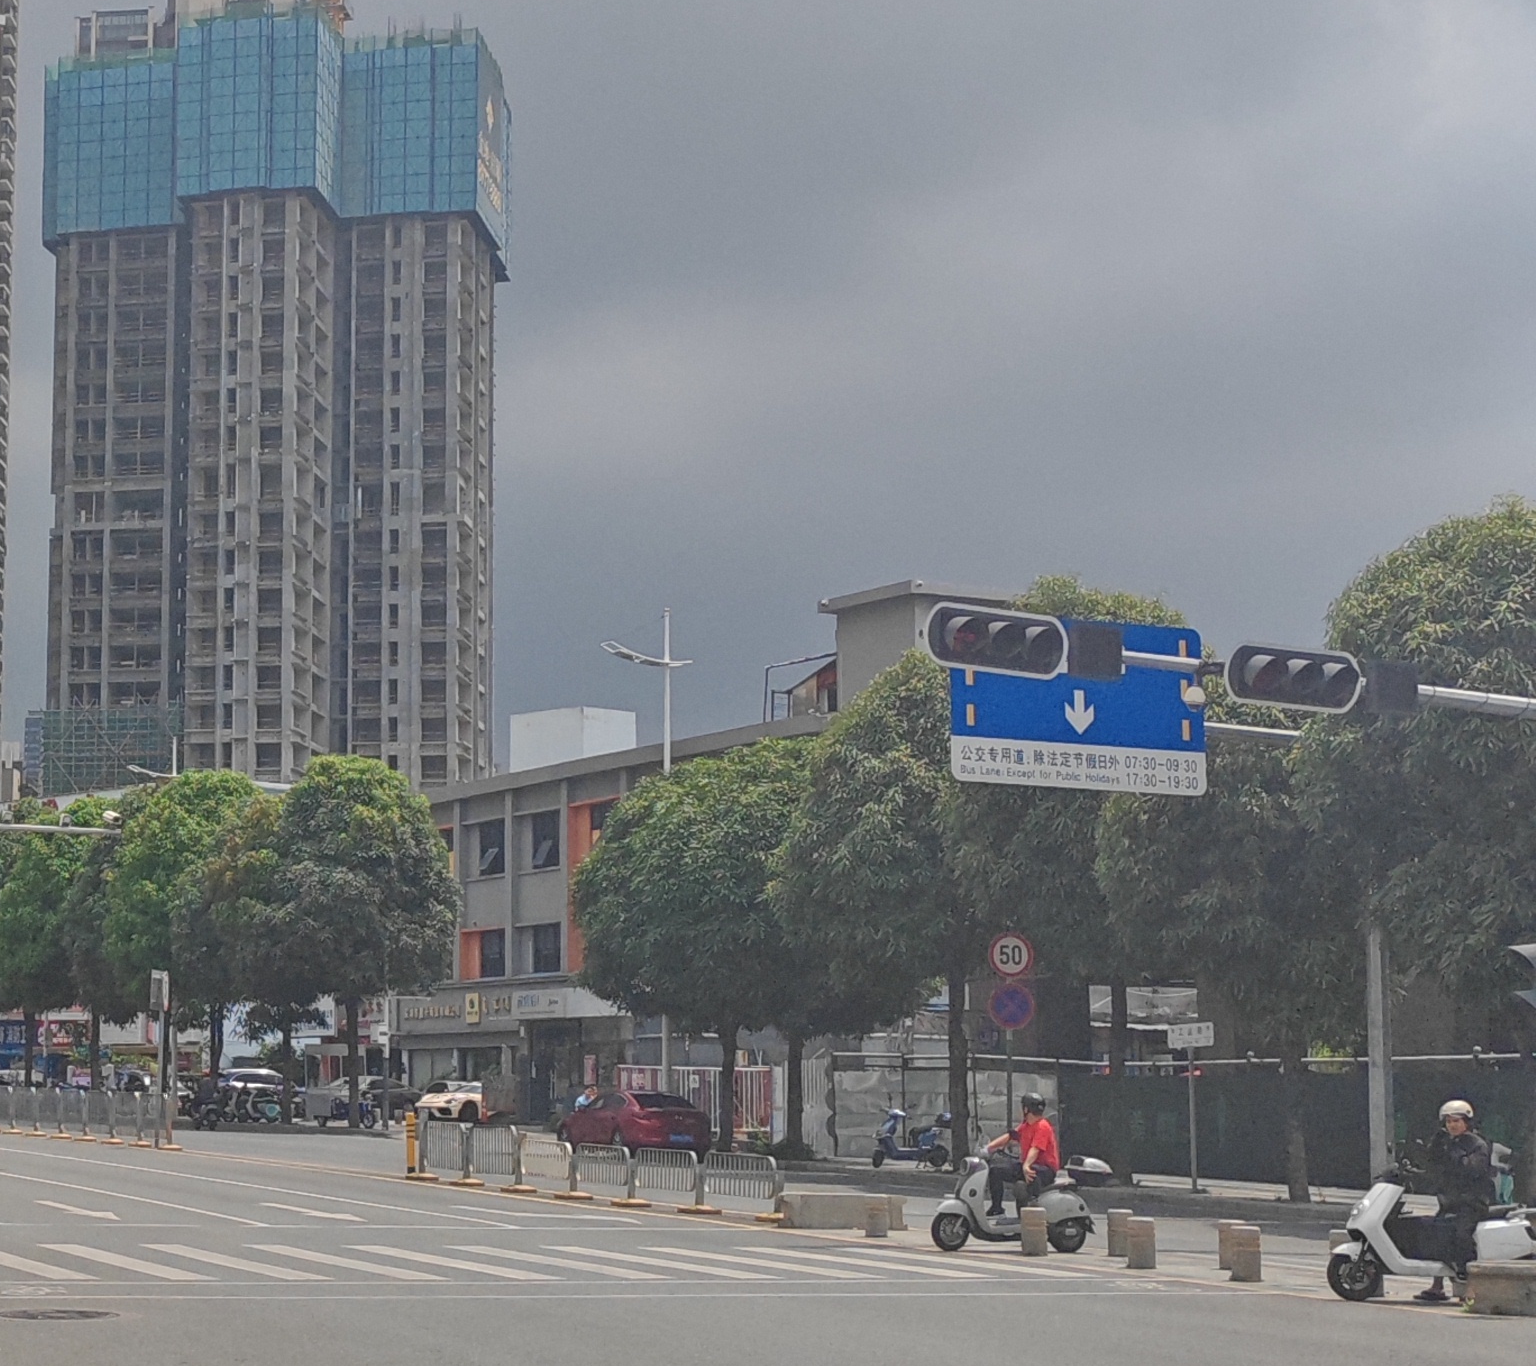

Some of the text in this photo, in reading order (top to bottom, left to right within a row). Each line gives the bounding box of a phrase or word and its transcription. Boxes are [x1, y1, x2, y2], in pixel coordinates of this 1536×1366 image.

[960, 764, 977, 776] Bus
[1056, 771, 1081, 782] Public
[999, 945, 1022, 965] 50
